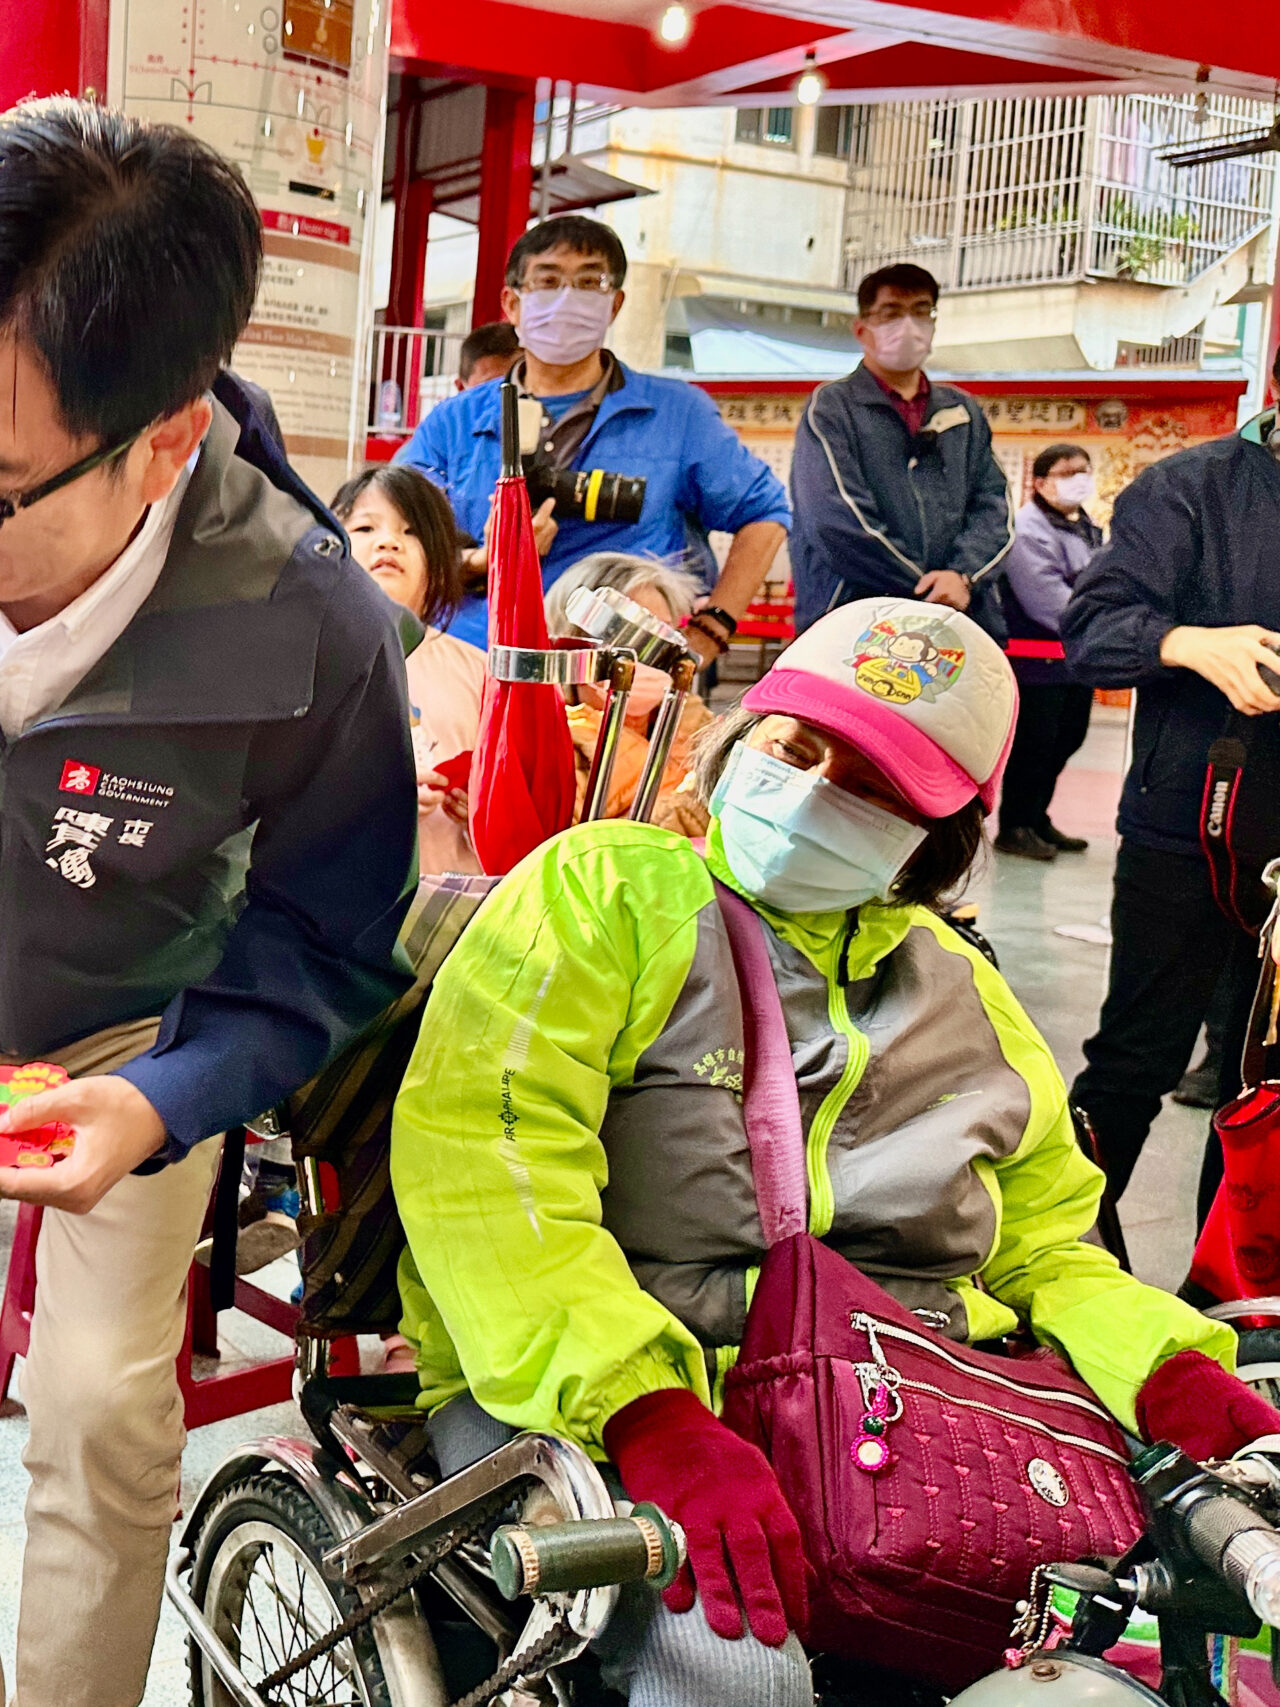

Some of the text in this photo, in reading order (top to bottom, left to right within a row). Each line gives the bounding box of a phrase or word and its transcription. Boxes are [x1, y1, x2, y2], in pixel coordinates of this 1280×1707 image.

[100, 781, 125, 792] CITY
[101, 773, 174, 797] KAOHSIUNG
[98, 788, 170, 808] GOVERNMENT
[1207, 781, 1229, 837] Canon
